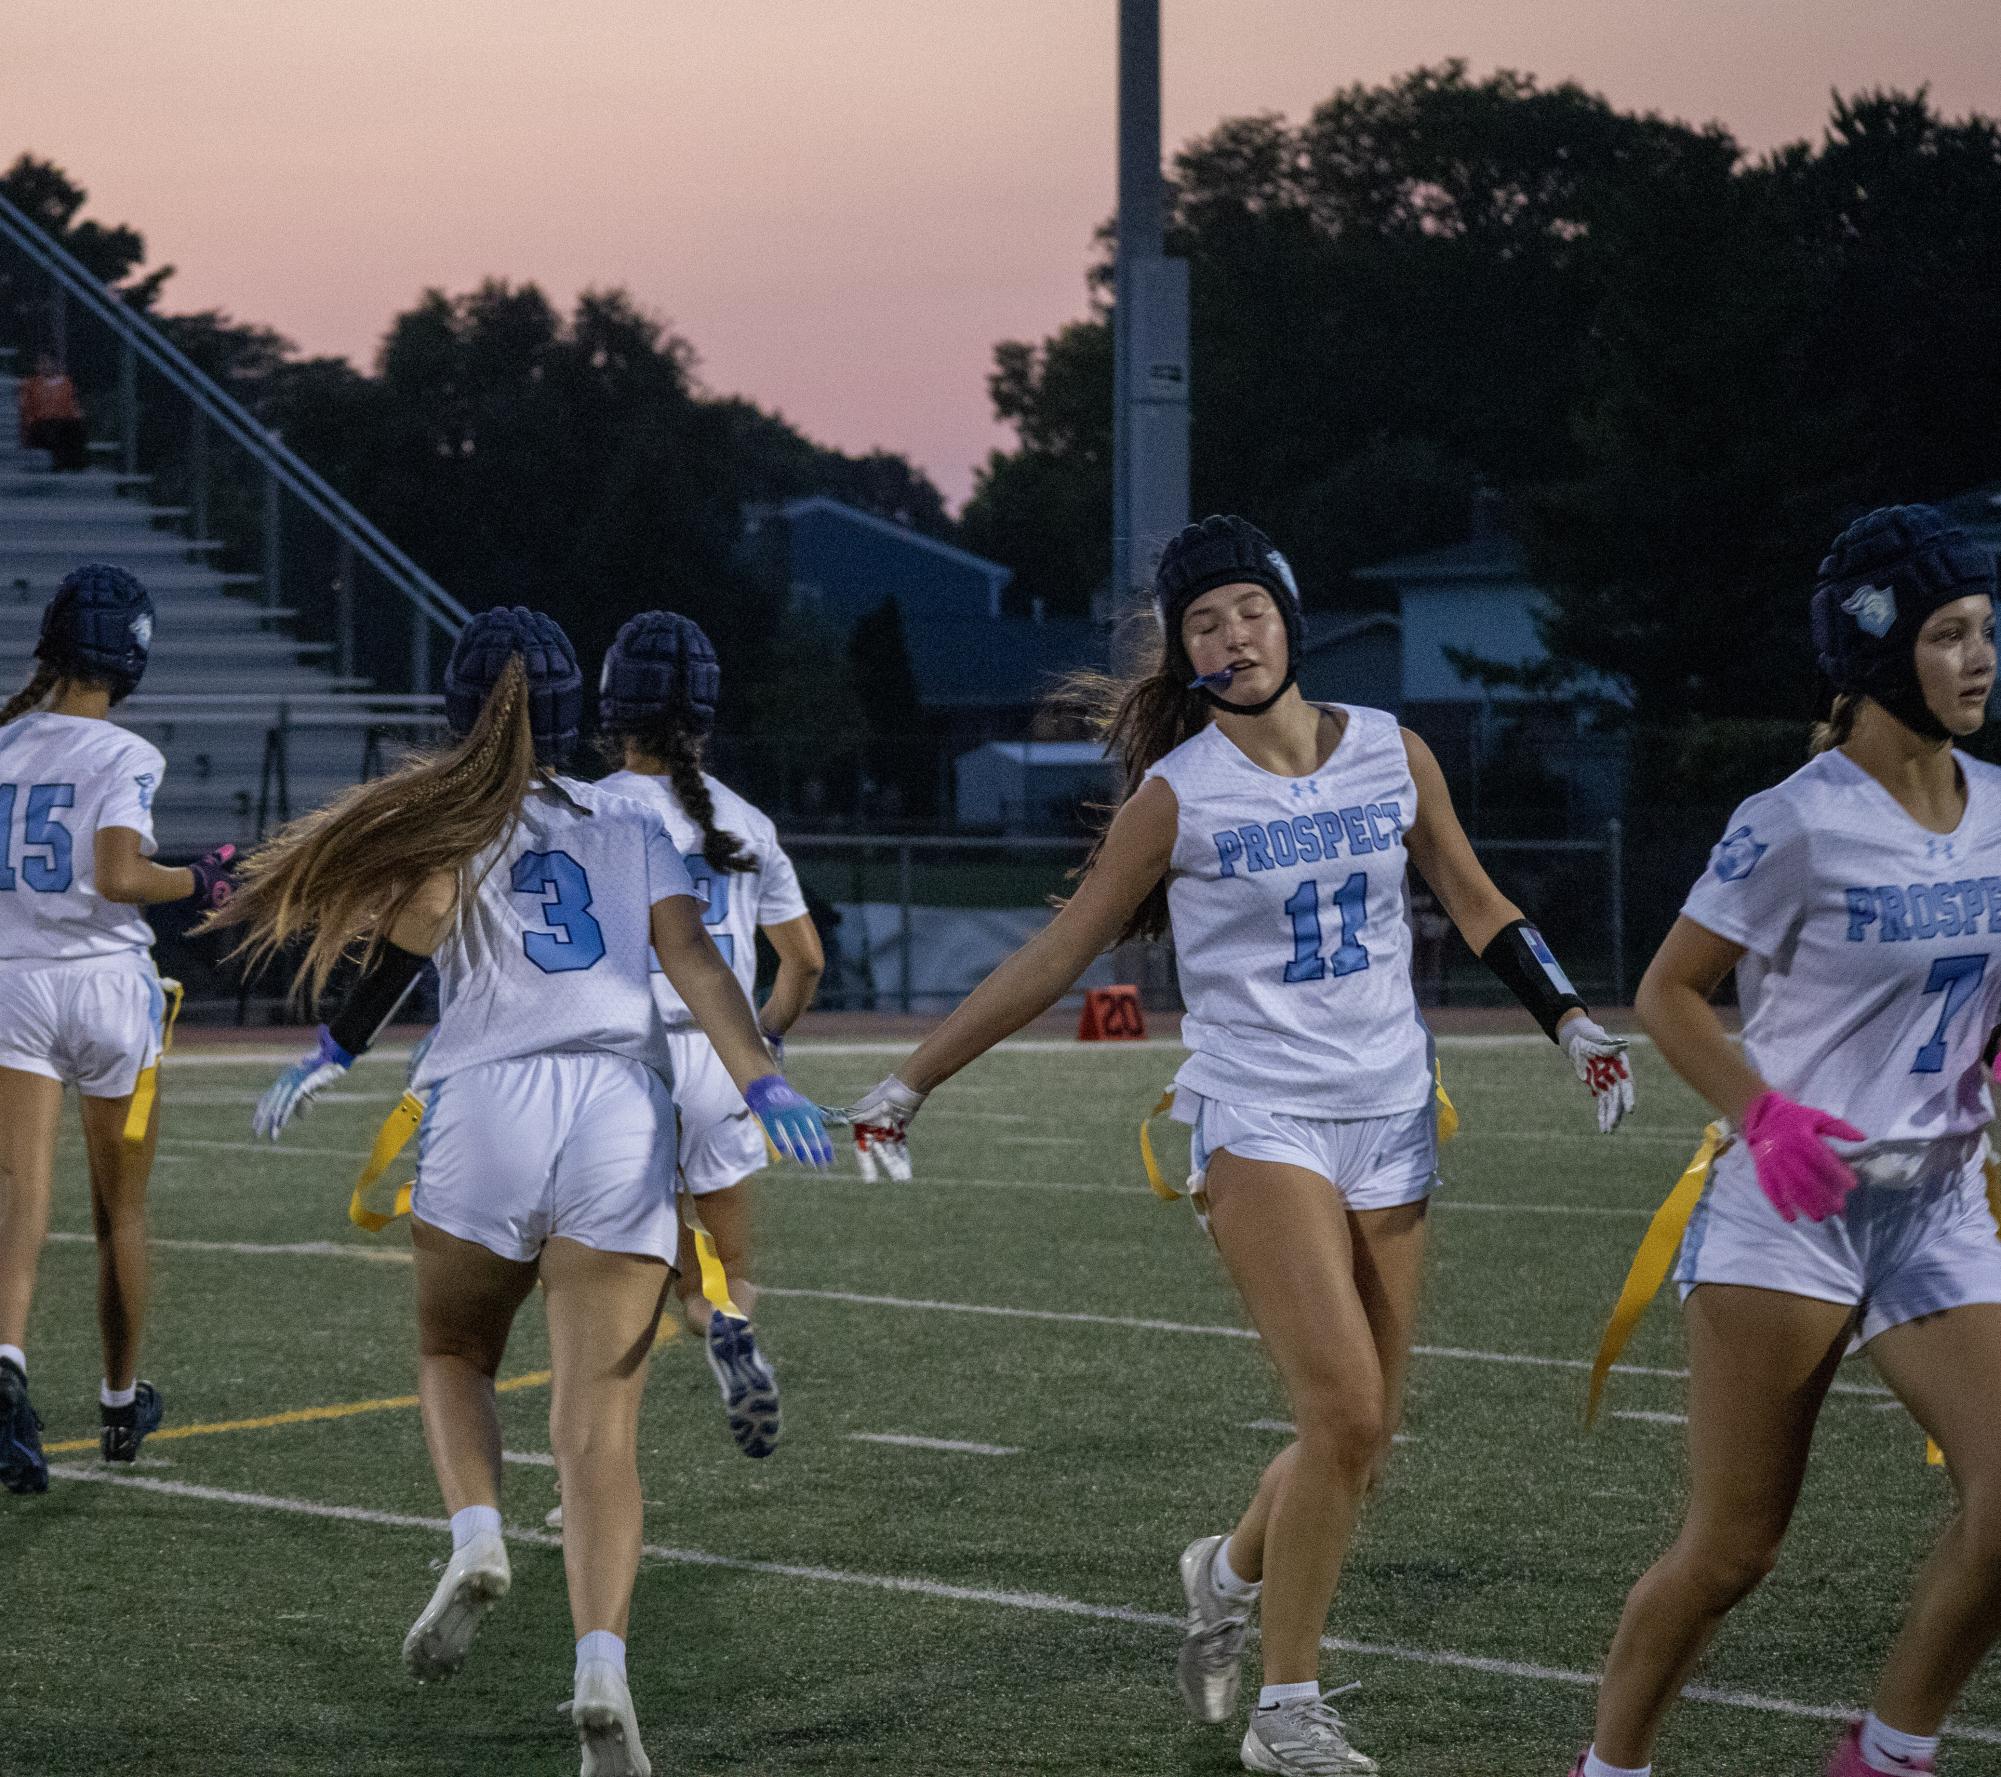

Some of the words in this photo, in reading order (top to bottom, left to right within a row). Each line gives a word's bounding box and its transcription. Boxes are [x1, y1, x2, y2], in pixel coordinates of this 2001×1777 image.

[1212, 801, 1402, 878] PROSPECT
[510, 850, 607, 974] 3
[1283, 871, 1370, 983] 11
[1098, 993, 1144, 1036] 20
[1909, 953, 1990, 1074] 7
